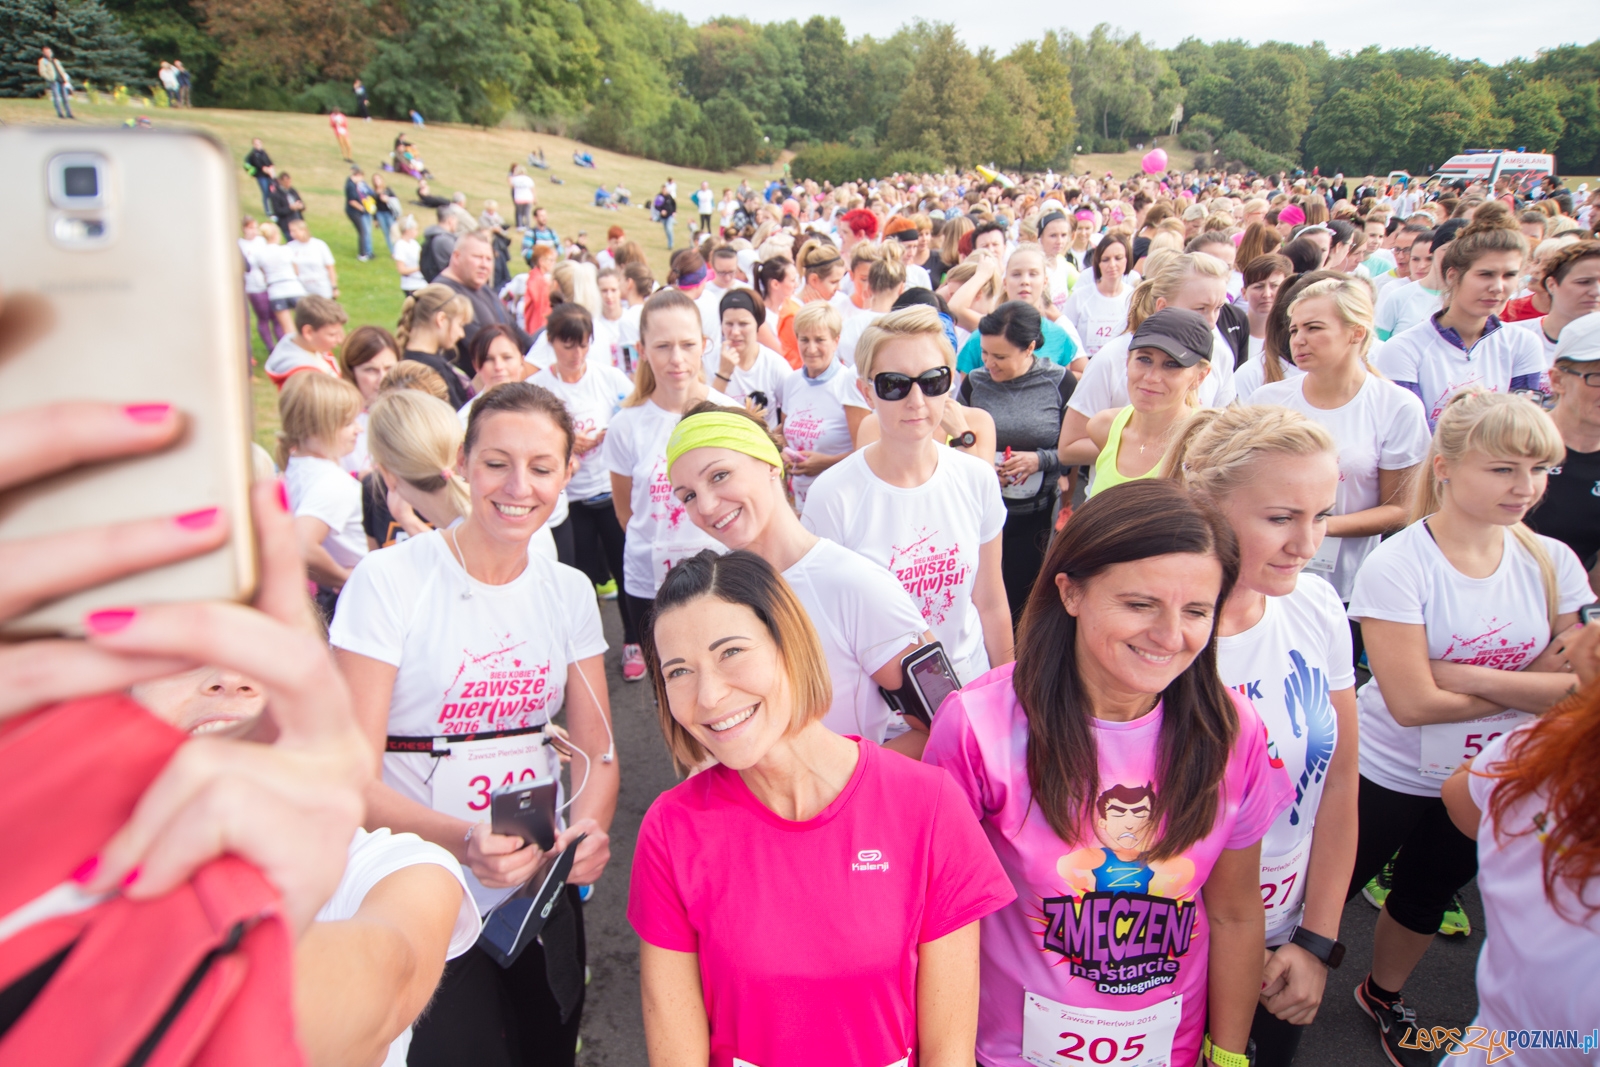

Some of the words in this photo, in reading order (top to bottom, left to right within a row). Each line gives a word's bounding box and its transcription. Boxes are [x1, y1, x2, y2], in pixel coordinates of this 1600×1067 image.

[1504, 157, 1547, 165] AMBULANS
[1096, 326, 1112, 337] 42
[651, 494, 670, 502] 2016
[927, 553, 947, 562] KOBIET
[896, 558, 956, 581] zawsze
[490, 671, 507, 679] BIEG
[509, 669, 536, 678] KOBIET
[460, 677, 545, 698] zawsze
[442, 720, 479, 734] 2016
[468, 752, 496, 761] Zawsze
[852, 862, 889, 872] Kalenji
[1045, 897, 1196, 970] ZMĘCZENI
[1073, 963, 1100, 980] na
[1106, 957, 1178, 982] starcie
[1098, 974, 1173, 994] Dobiegniew
[1060, 1013, 1095, 1025] Zawsze
[1096, 1019, 1136, 1027] Pier(w)si
[1136, 1014, 1158, 1025] 2016
[1056, 1031, 1147, 1064] 205
